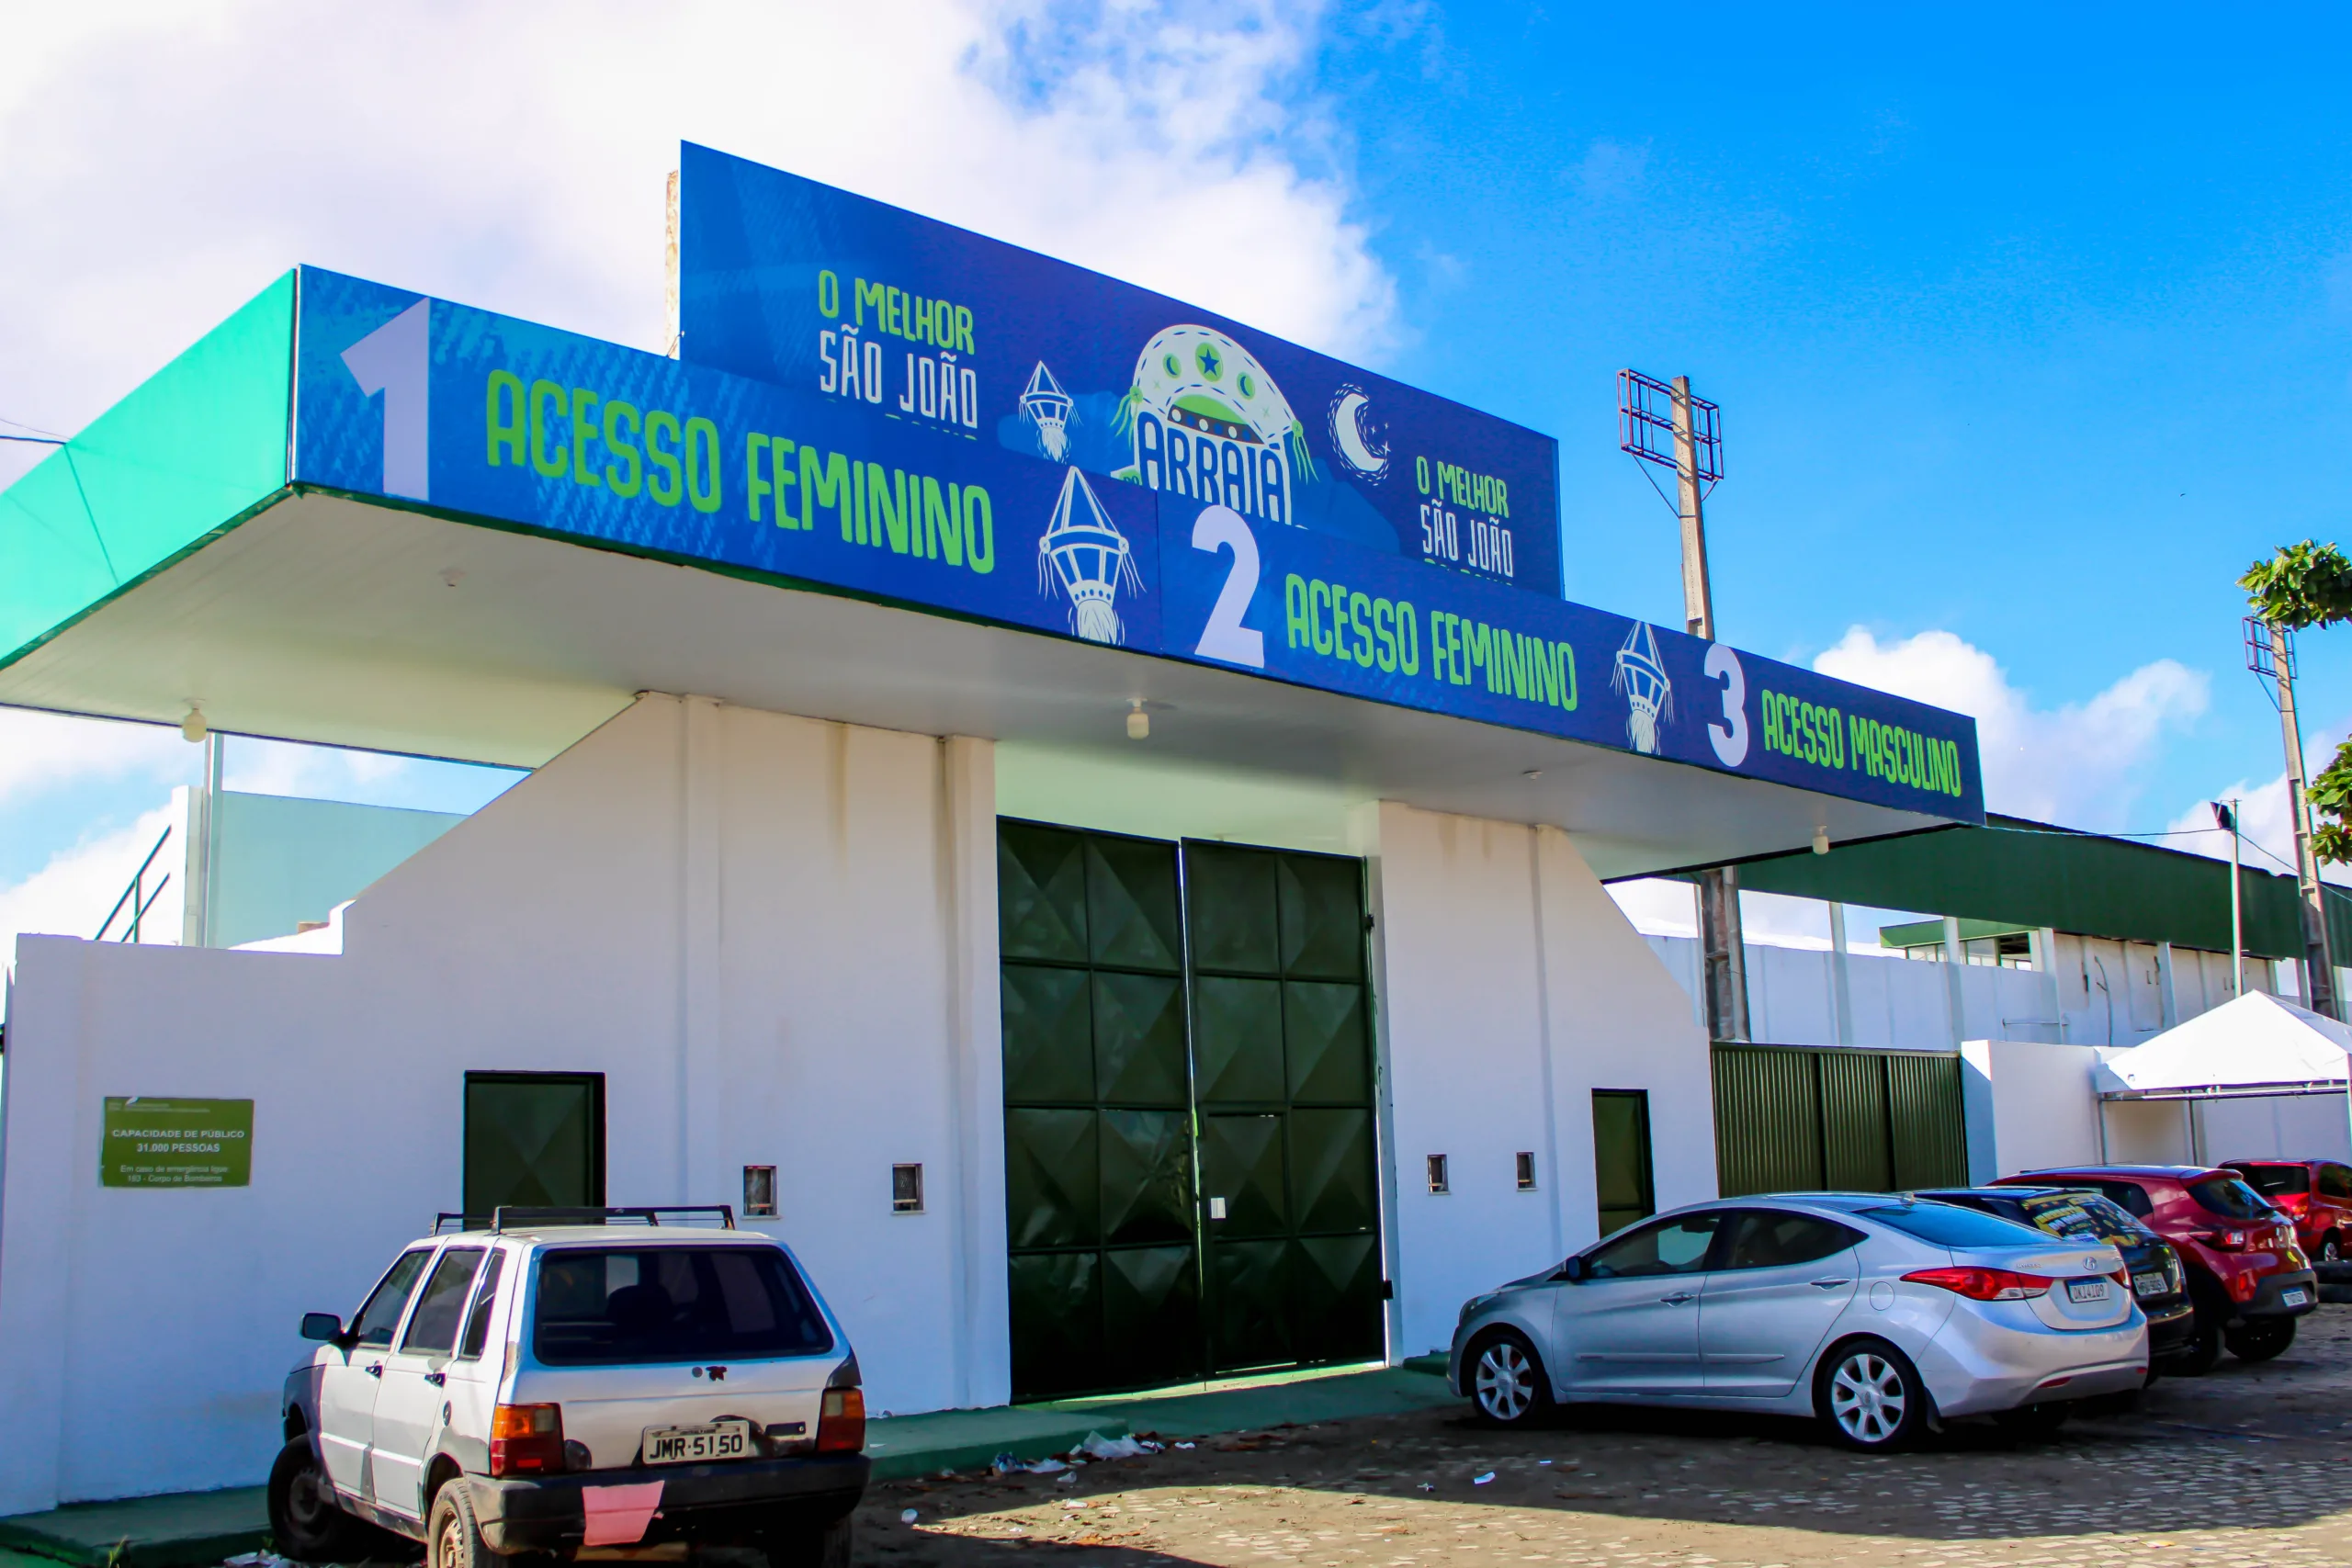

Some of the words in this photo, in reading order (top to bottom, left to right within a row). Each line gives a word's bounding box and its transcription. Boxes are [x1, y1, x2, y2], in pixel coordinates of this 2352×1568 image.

[819, 270, 839, 319] O
[854, 277, 975, 355] MELHOR
[820, 323, 882, 404] SÃO
[899, 351, 978, 429] JOÃO
[341, 297, 428, 501] 1
[486, 369, 722, 513] ACESSO
[747, 433, 994, 574] FEMININO
[1416, 456, 1430, 494] O
[1437, 461, 1510, 518] MELHOR
[1419, 498, 1459, 562] SÃO
[1467, 516, 1513, 578] JOÃO
[1192, 504, 1265, 669] 2
[1285, 573, 1419, 676] ACESSO
[1430, 611, 1577, 711] FEMININO
[1703, 643, 1748, 768] 3
[1761, 689, 1845, 770] ACESSO
[1849, 715, 1962, 798] MASCULINO
[112, 1129, 182, 1138] CAPACIDADE
[184, 1130, 199, 1138] DE
[200, 1127, 245, 1139] PÚBLICO
[137, 1143, 170, 1153] 31.000
[172, 1143, 220, 1153] PESSOAS
